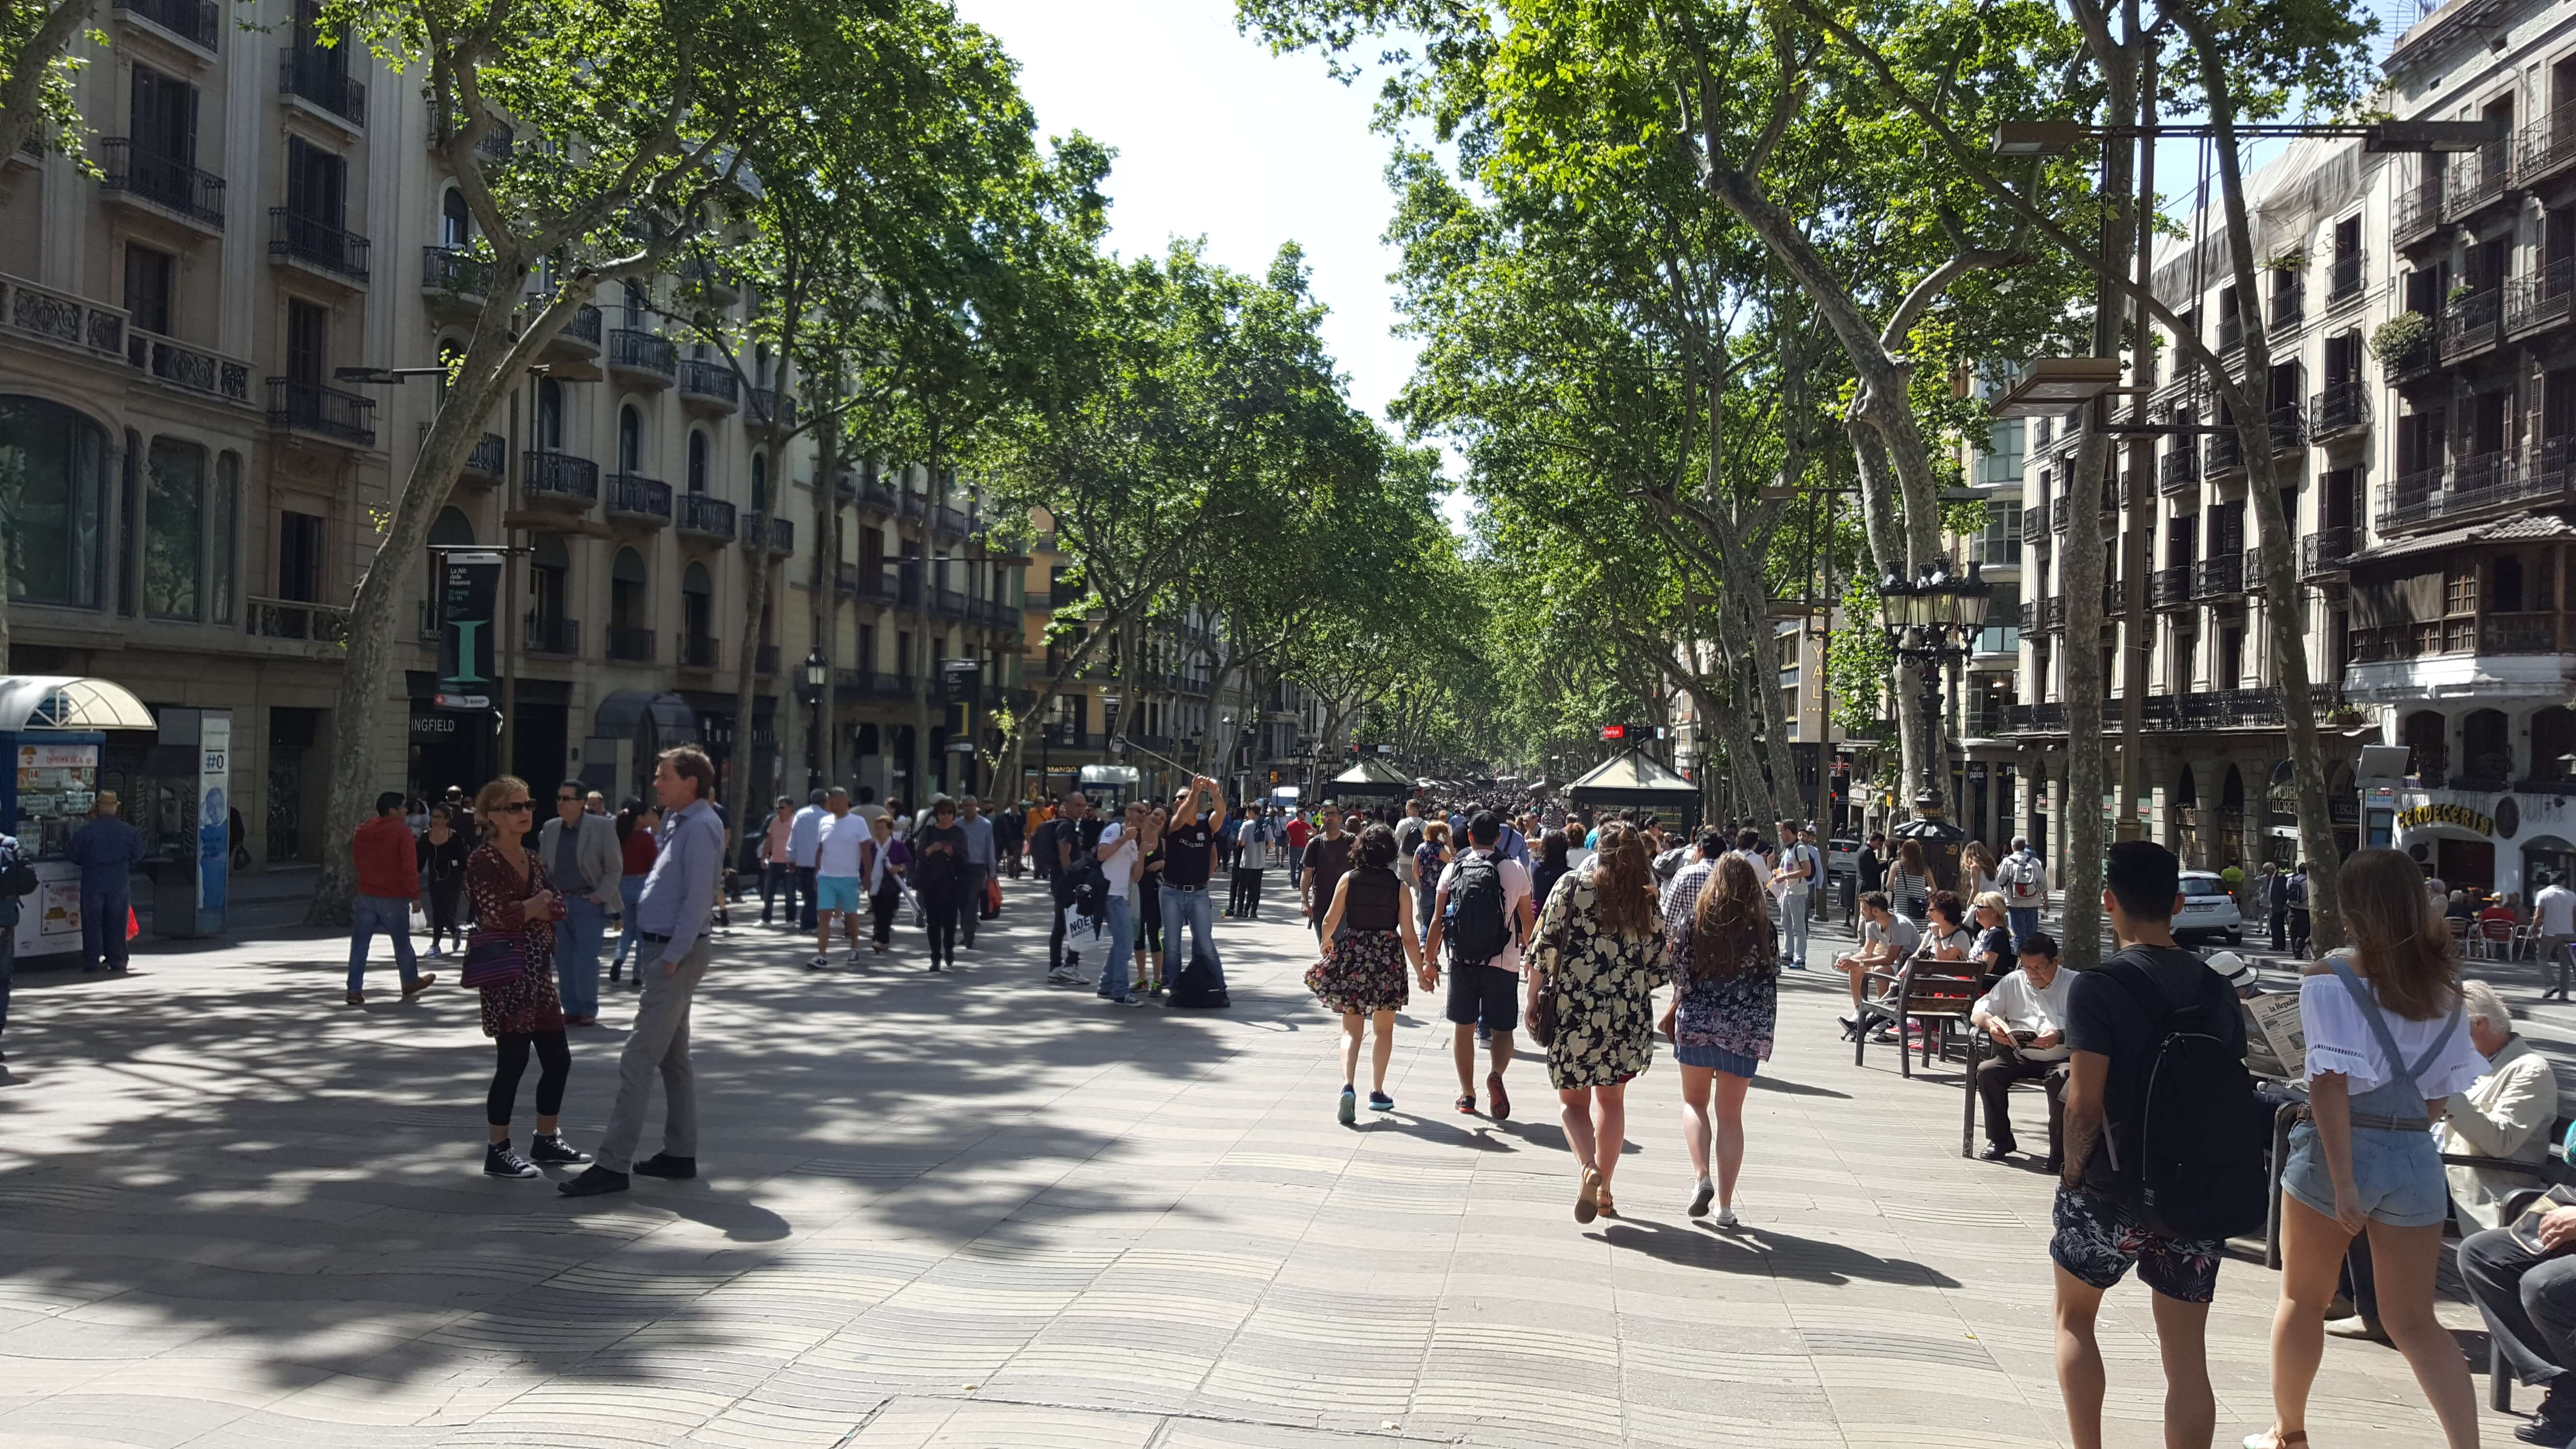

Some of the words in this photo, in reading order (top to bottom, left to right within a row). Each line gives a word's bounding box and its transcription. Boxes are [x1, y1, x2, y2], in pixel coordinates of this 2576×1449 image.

[411, 718, 455, 732] INGFIELD
[205, 754, 224, 769] #0
[2007, 766, 2015, 775] pa
[2275, 997, 2299, 1010] Repubb
